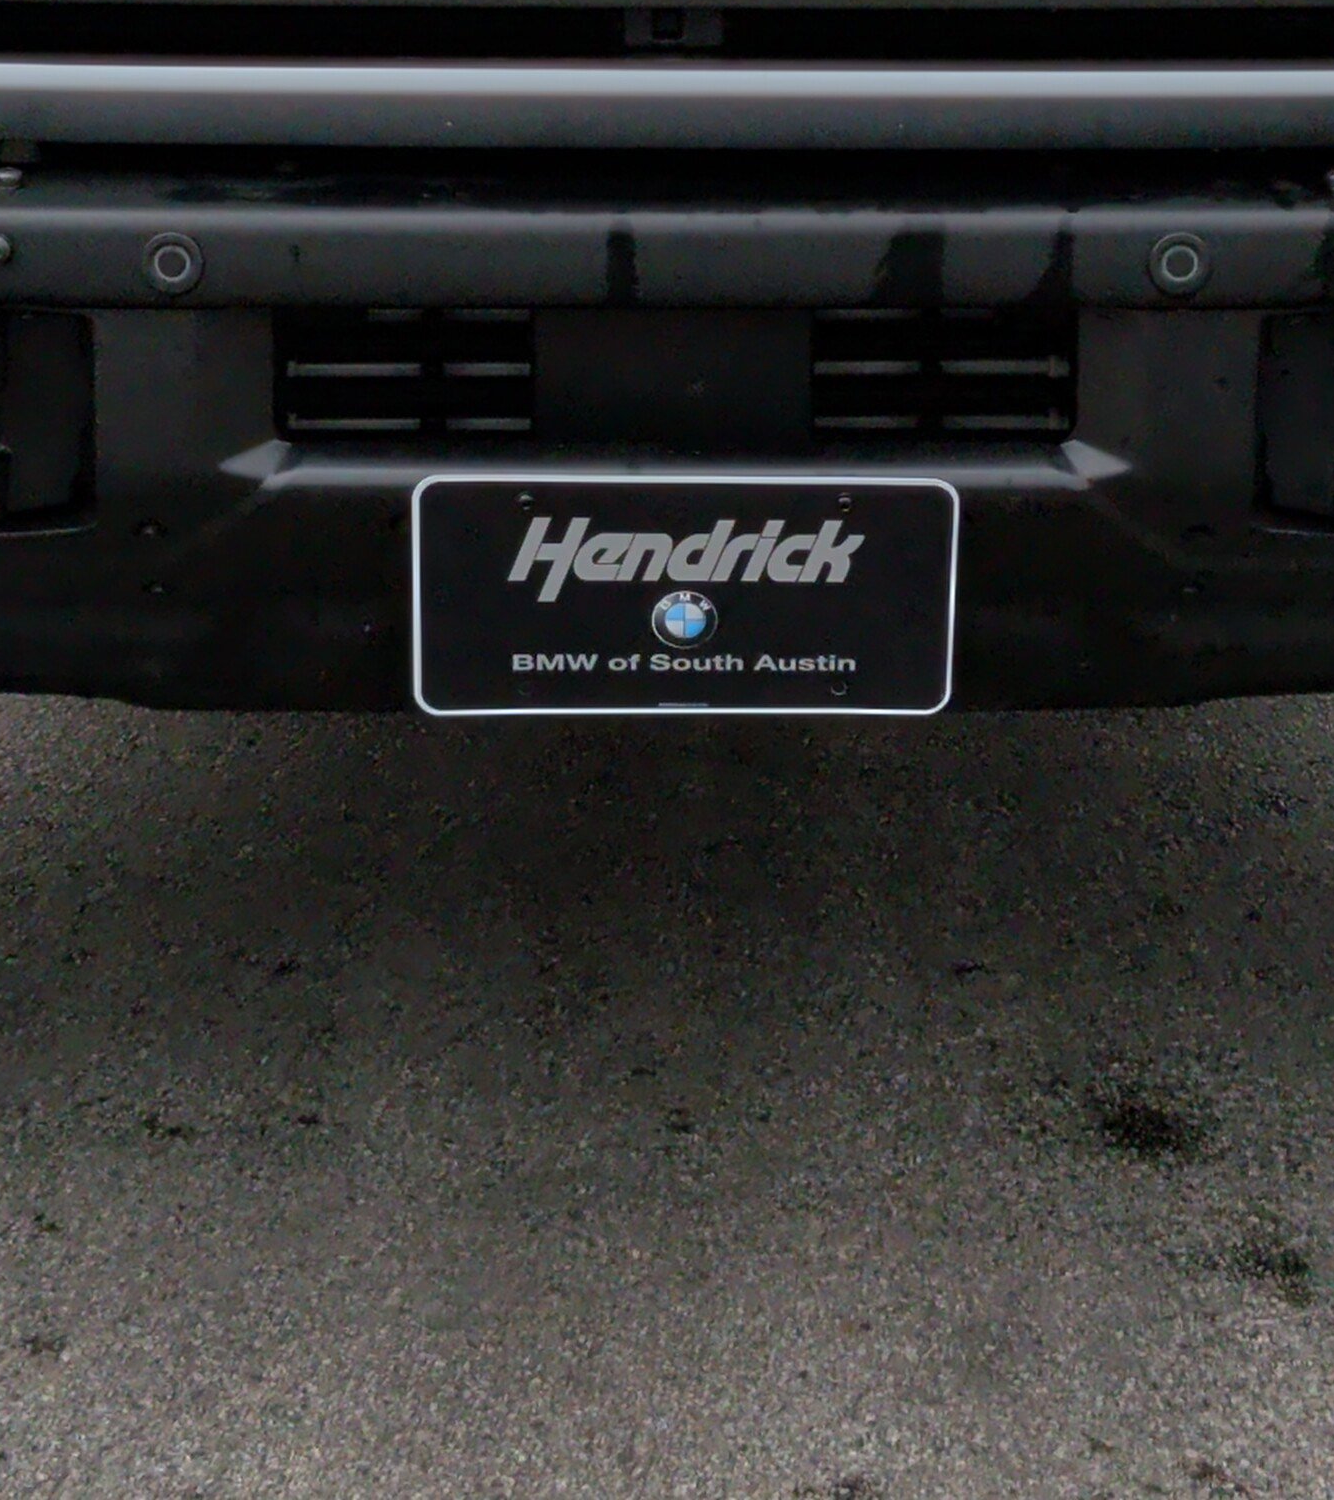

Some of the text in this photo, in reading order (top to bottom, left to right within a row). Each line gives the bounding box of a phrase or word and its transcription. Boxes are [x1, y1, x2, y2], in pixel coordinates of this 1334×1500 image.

[507, 516, 866, 602] Hendrick
[512, 653, 857, 672] BMW of South Austin
